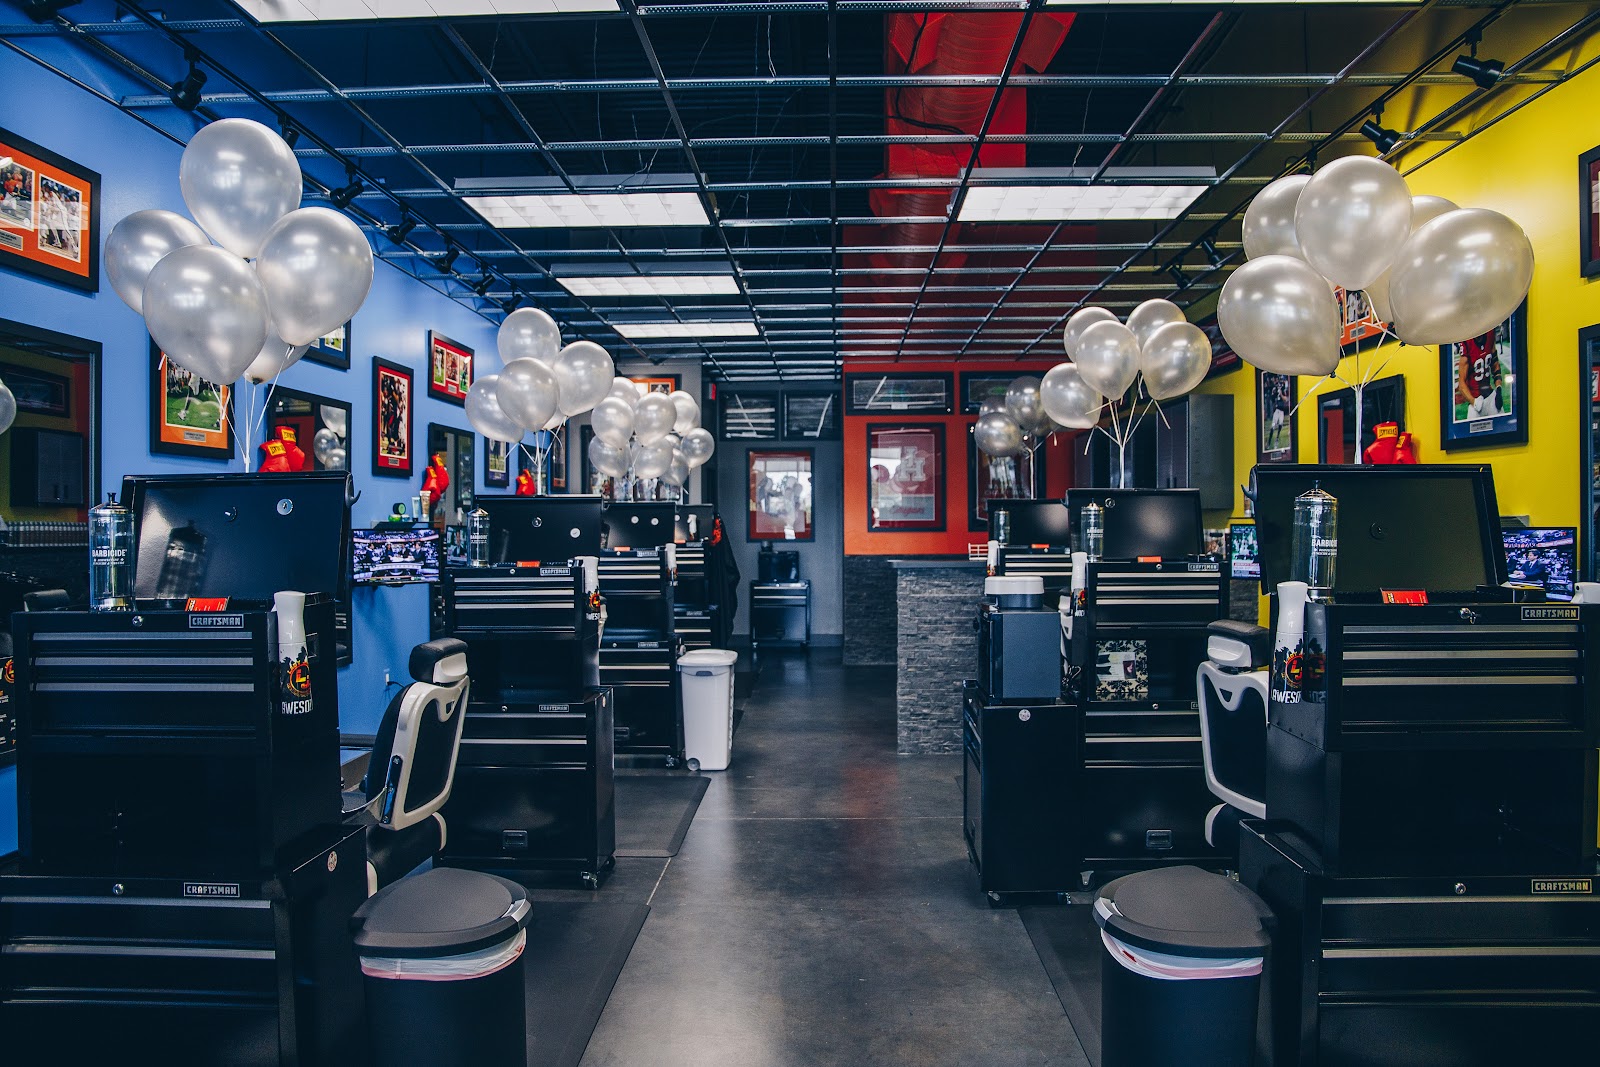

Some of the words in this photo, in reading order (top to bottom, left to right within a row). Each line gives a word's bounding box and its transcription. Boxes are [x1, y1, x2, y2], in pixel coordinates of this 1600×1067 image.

[1524, 609, 1577, 618] CRAFTSMAN
[192, 617, 241, 626] CRAFTSMAN
[282, 699, 313, 715] AWESO
[186, 885, 237, 895] CRAFTSMAN
[1534, 882, 1589, 891] CRAFTSMAN
